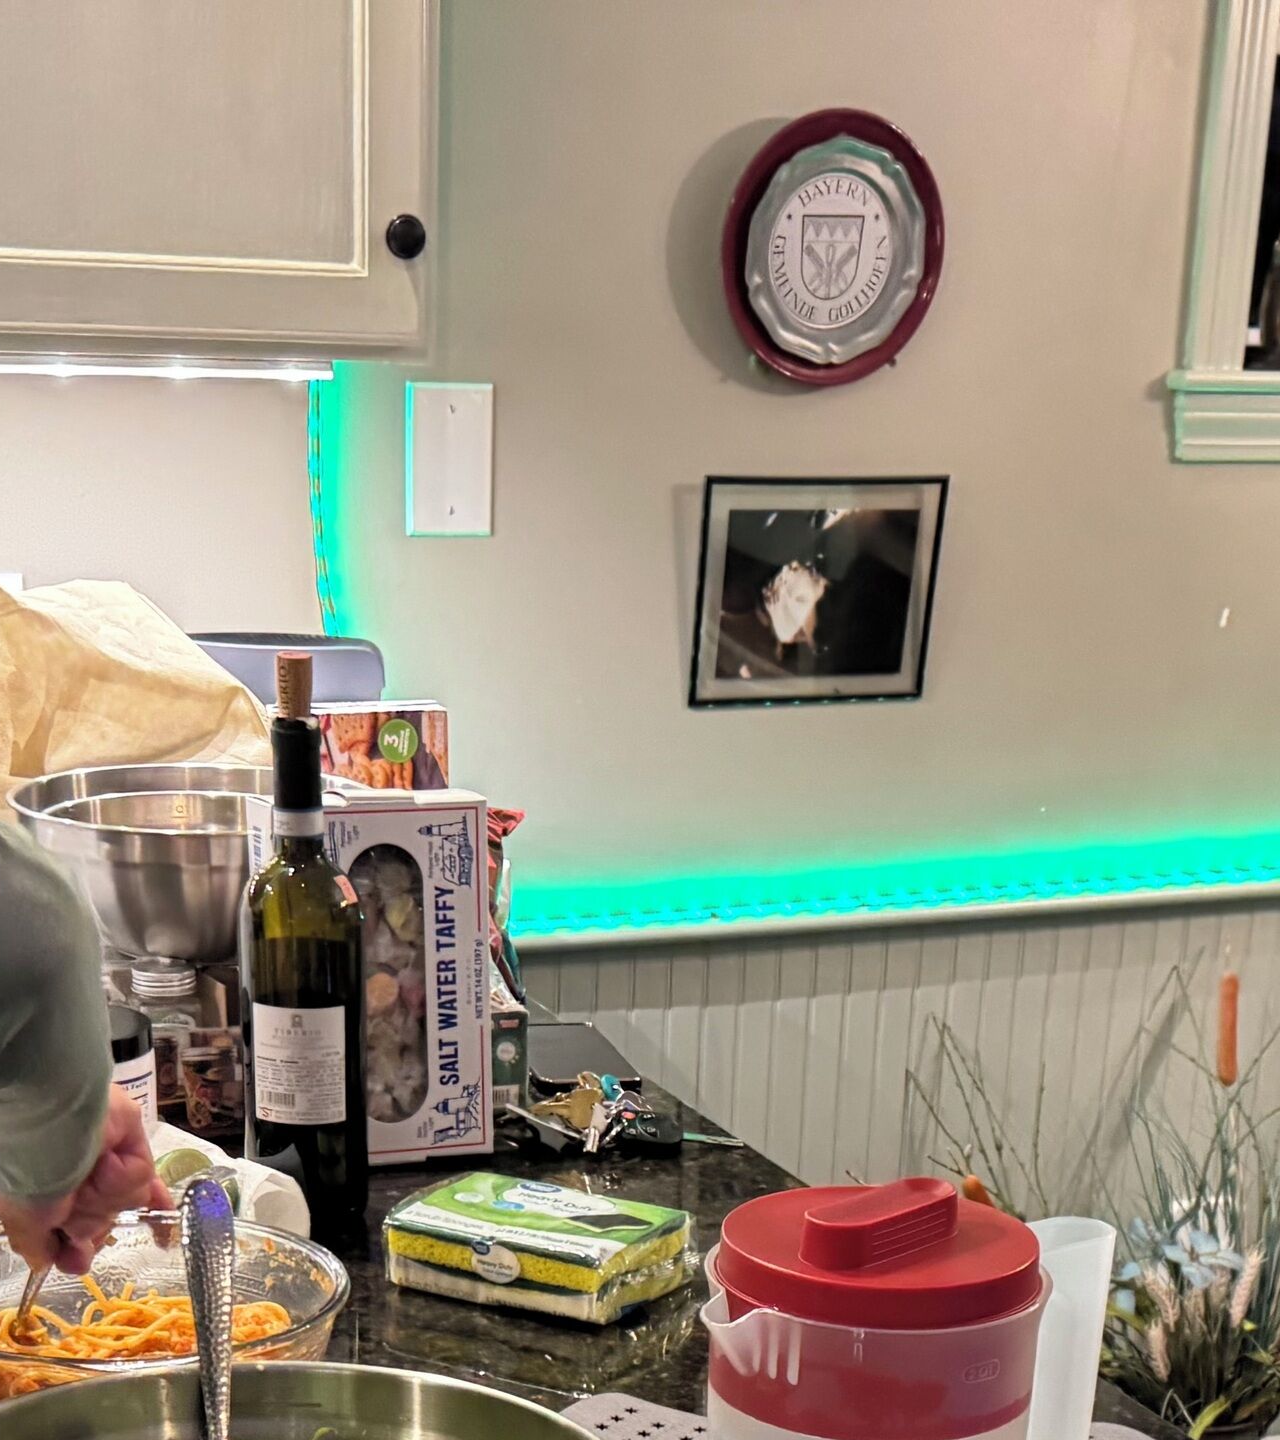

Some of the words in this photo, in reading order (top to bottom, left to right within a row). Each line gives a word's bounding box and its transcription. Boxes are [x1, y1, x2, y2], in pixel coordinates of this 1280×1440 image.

[383, 734, 399, 748] 3
[434, 885, 456, 952] TAFFY
[436, 959, 458, 1031] WATER
[474, 978, 482, 988] 14
[475, 1003, 484, 1019] NET
[438, 1038, 460, 1086] SALT
